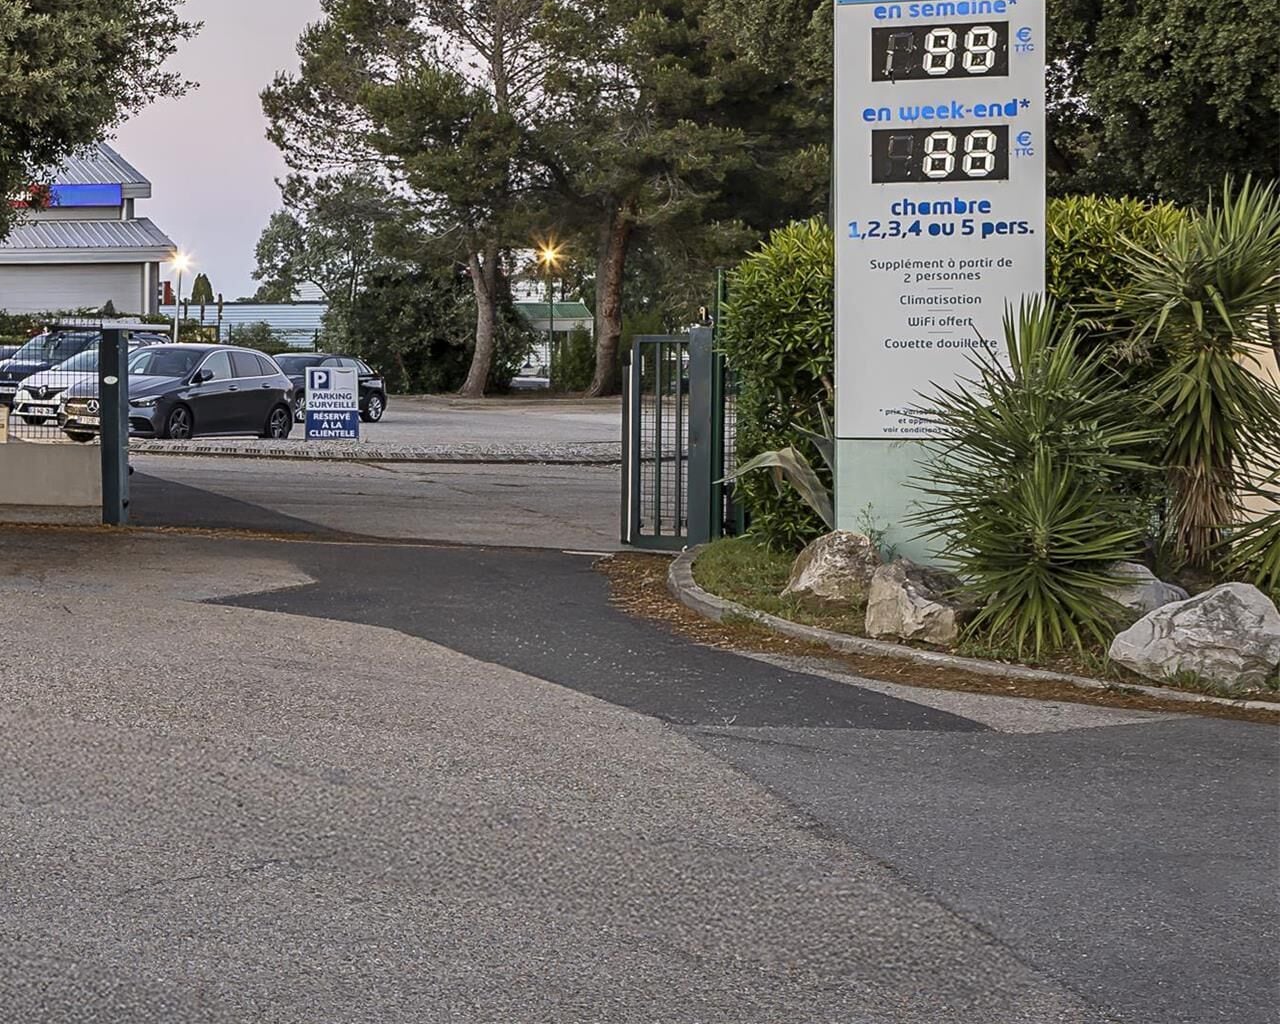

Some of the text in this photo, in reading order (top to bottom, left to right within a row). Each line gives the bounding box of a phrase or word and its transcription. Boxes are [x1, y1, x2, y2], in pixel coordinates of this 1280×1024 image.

[874, 4, 902, 19] en
[1016, 27, 1033, 43] €
[1015, 43, 1035, 53] TTC
[862, 107, 891, 122] en
[1016, 131, 1033, 147] €
[1015, 147, 1035, 157] TTC
[891, 197, 992, 216] chambre
[848, 219, 1035, 240] 1,2,3,4 ou 5 pers.
[870, 257, 1013, 270] Supplément à partir de
[904, 271, 981, 283] 2 personnes
[900, 294, 982, 305] Climatisation
[907, 316, 973, 327] WiFi offert
[884, 338, 998, 349] Couette douillette
[313, 372, 327, 389] P
[312, 392, 352, 400] PARKING
